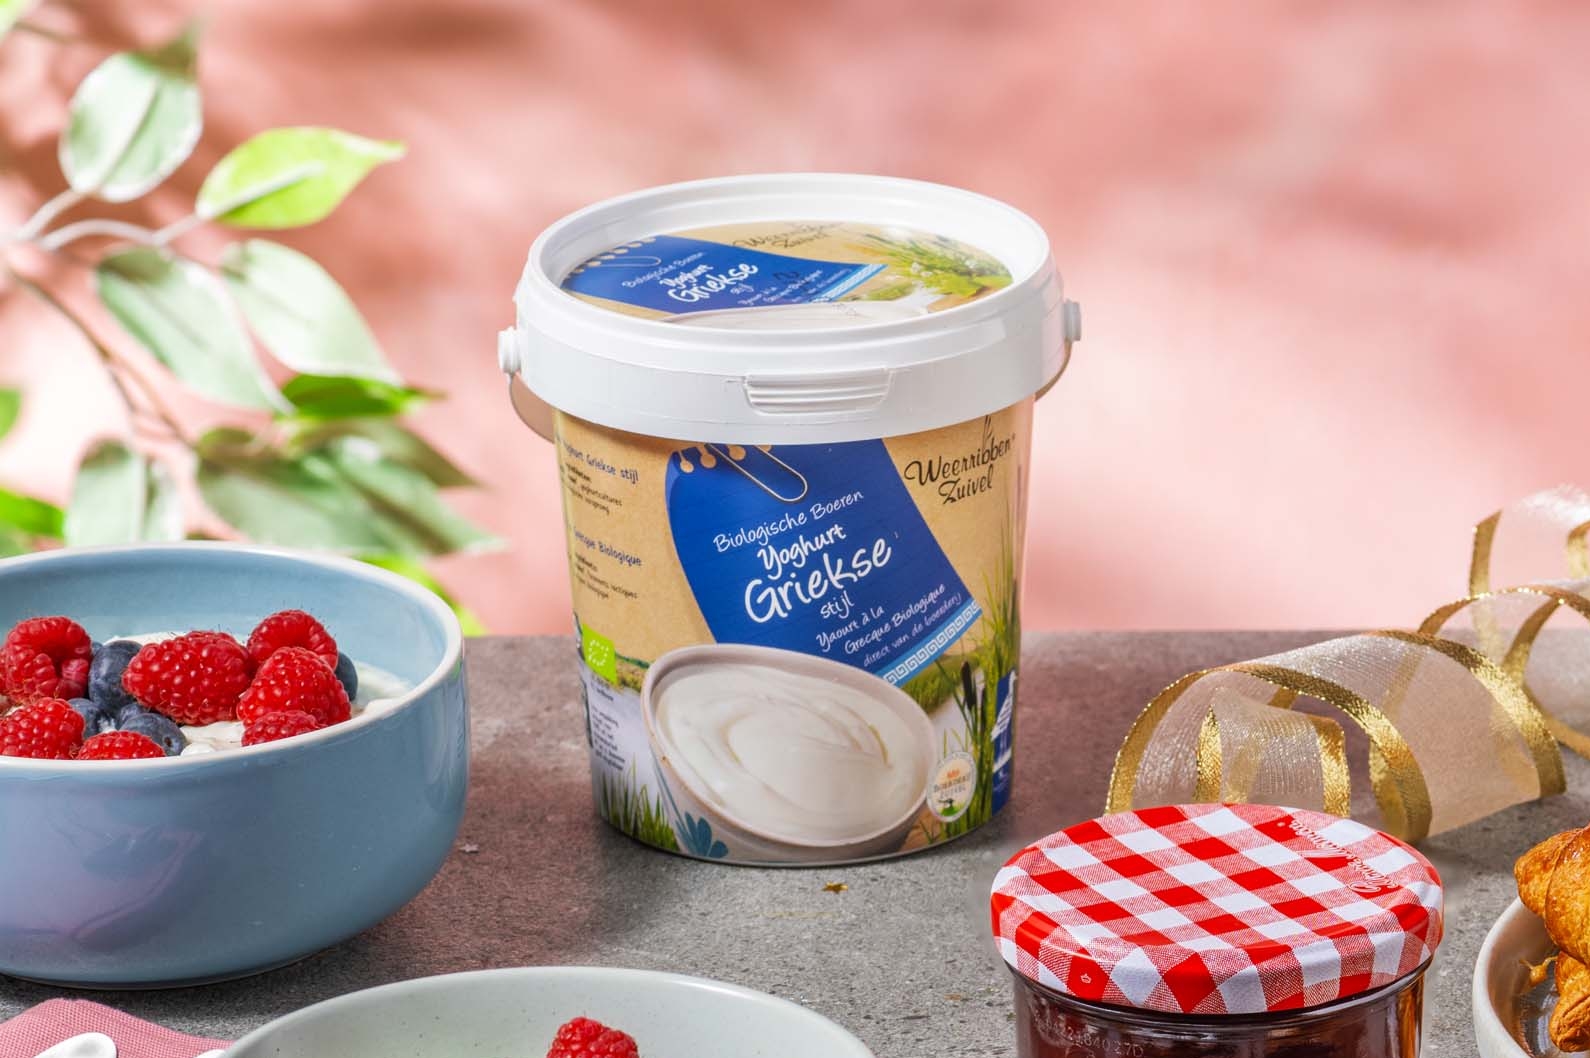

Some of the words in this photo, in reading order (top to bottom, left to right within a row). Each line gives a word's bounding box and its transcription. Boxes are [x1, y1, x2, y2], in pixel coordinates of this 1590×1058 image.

[667, 262, 759, 303] Griekse
[938, 464, 994, 505] Zuivel
[712, 512, 808, 552] Biologische
[809, 490, 864, 520] Boeren
[757, 523, 847, 580] Yoghurt
[744, 537, 892, 624] Griekse
[820, 590, 855, 619] stijl
[816, 620, 860, 653] Yaourt
[871, 605, 885, 619] la
[844, 622, 892, 655] Grecque
[892, 583, 946, 627] Biologique
[863, 645, 891, 668] direct
[891, 634, 910, 650] van
[912, 622, 924, 638] de
